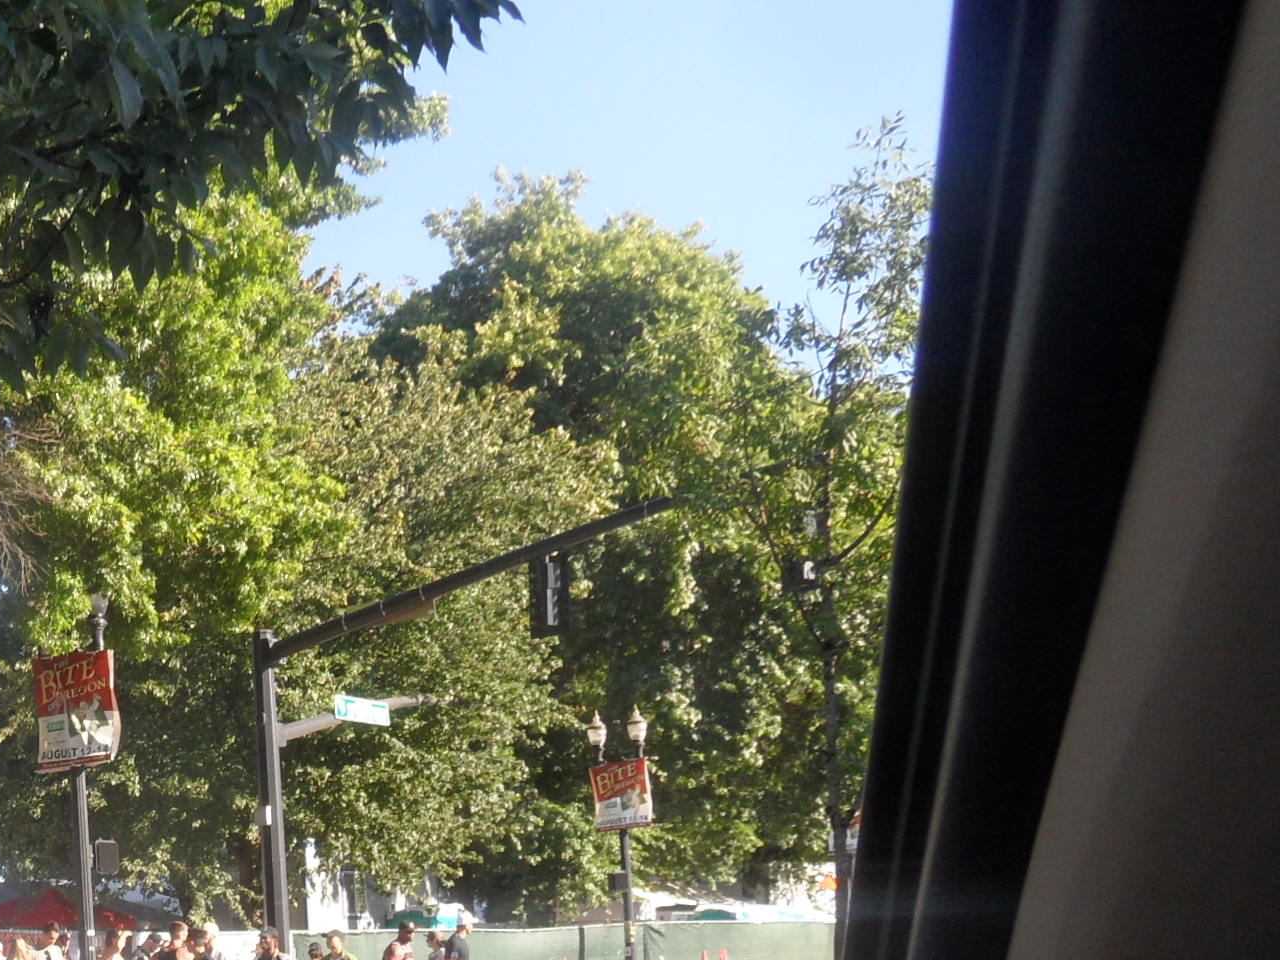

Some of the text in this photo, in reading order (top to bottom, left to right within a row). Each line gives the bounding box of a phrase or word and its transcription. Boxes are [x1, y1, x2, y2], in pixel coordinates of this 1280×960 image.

[37, 657, 96, 705] BITE
[40, 745, 108, 761] AUGUST 12-14
[596, 763, 637, 794] BITE
